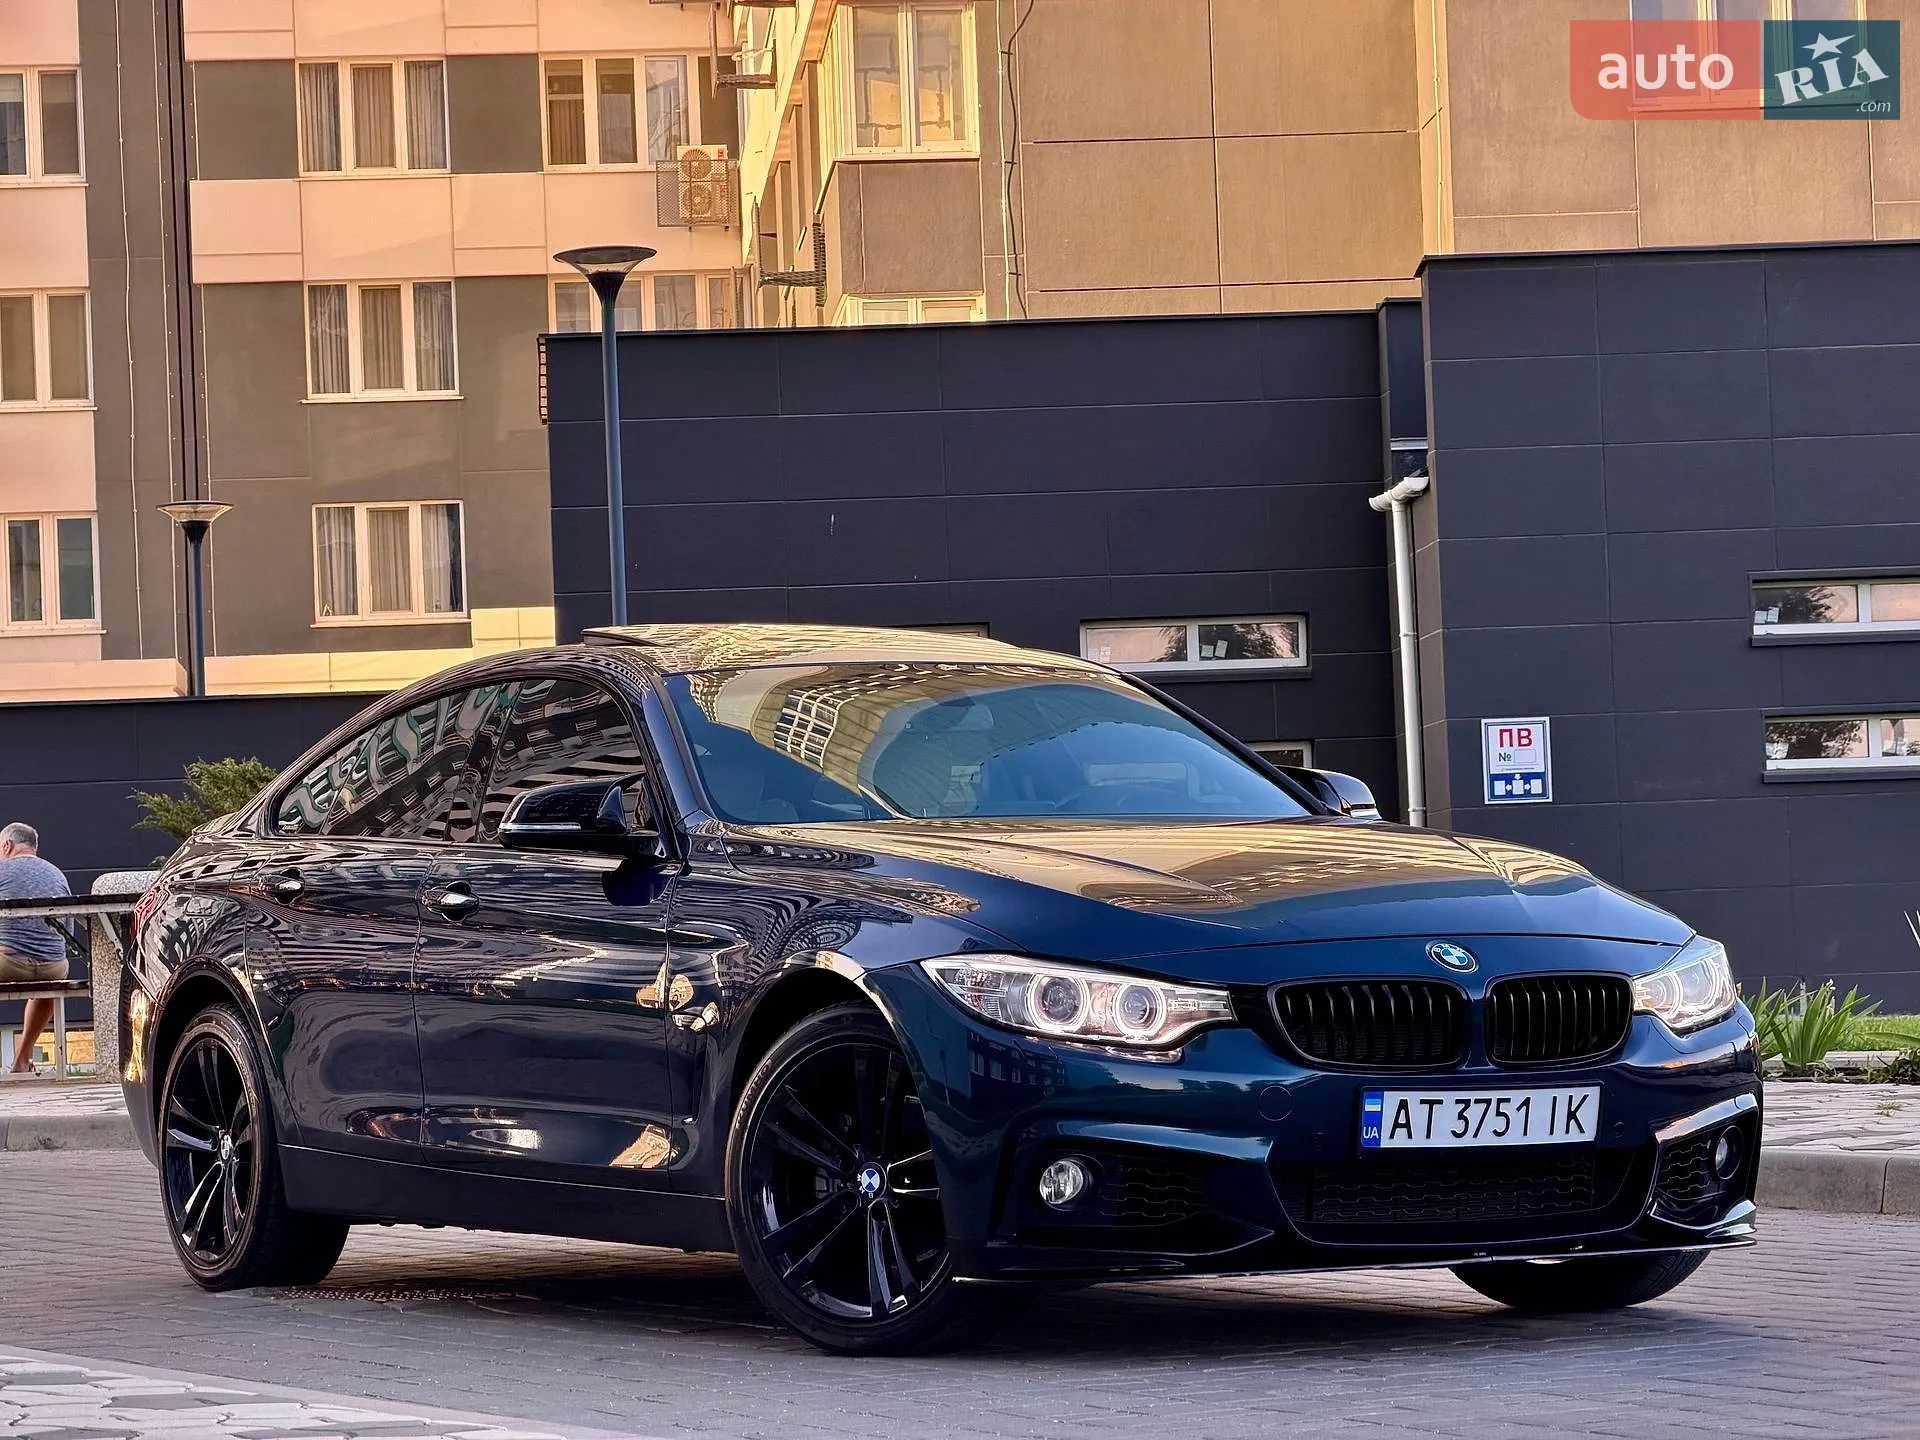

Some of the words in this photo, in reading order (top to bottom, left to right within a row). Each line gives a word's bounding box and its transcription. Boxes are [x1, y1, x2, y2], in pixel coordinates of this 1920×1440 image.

[1499, 728, 1533, 748] ПВ
[1499, 752, 1512, 762] №
[1389, 1098, 1444, 1139] AT
[1450, 1097, 1532, 1138] 3751
[1549, 1094, 1590, 1136] IK
[1363, 1127, 1379, 1139] UA
